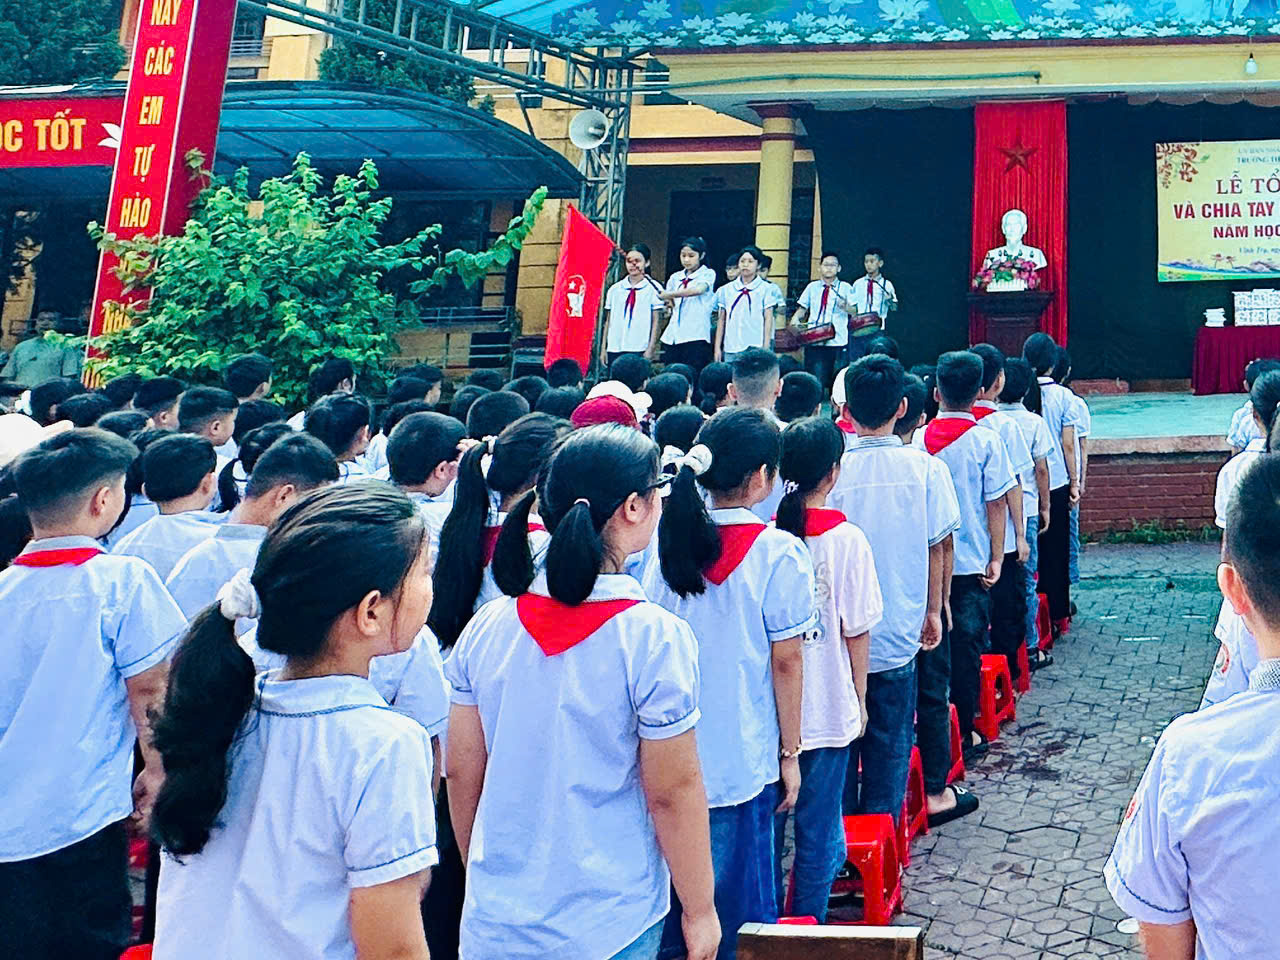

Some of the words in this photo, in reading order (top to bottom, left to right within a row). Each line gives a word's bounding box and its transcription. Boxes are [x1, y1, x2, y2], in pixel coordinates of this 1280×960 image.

[144, 40, 175, 76] CÁC
[138, 95, 163, 125] EM
[33, 107, 87, 151] TỐT
[134, 144, 155, 185] TỰ
[1216, 170, 1243, 195] LỄ
[120, 192, 152, 228] HÀO
[1173, 201, 1196, 219] VÀ
[1201, 201, 1242, 219] CHIA
[1247, 200, 1276, 218] TAY
